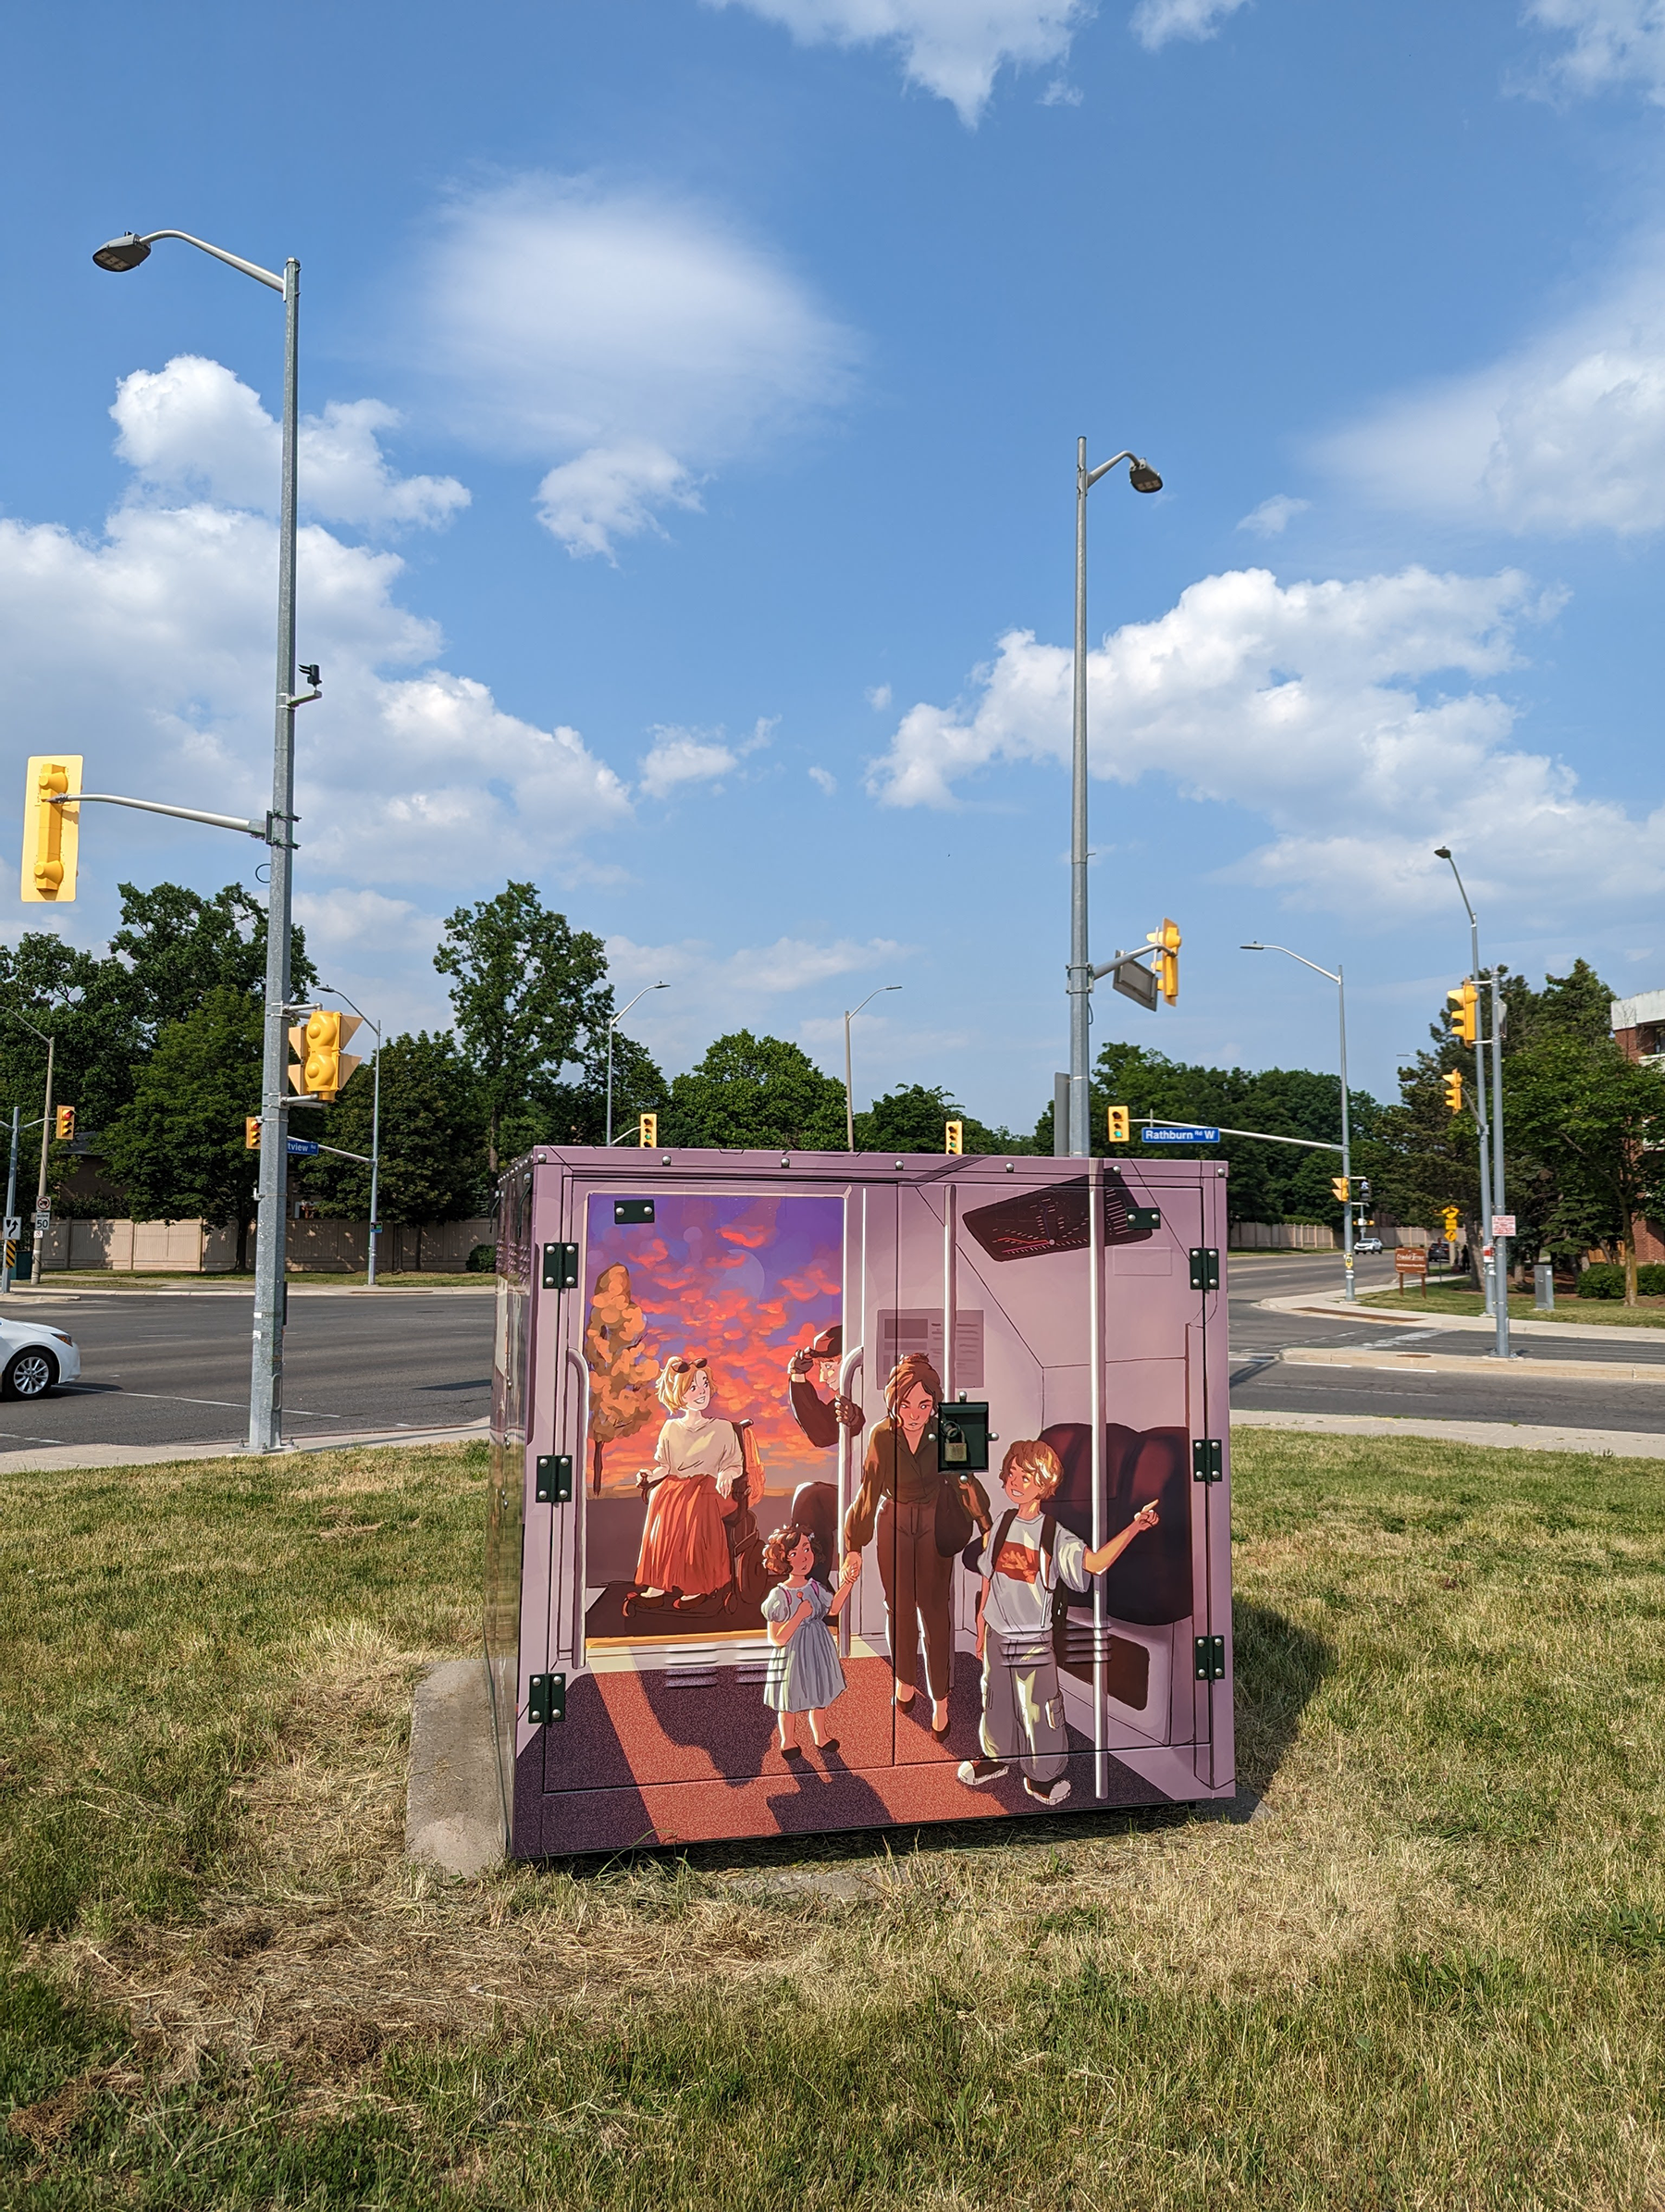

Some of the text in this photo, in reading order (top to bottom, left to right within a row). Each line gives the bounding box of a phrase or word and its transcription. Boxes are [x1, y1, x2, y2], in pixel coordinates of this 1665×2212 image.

[1145, 1131, 1193, 1139] Rathburn
[1204, 1131, 1215, 1139] W
[288, 1143, 308, 1152] tview
[37, 1219, 48, 1229] 50
